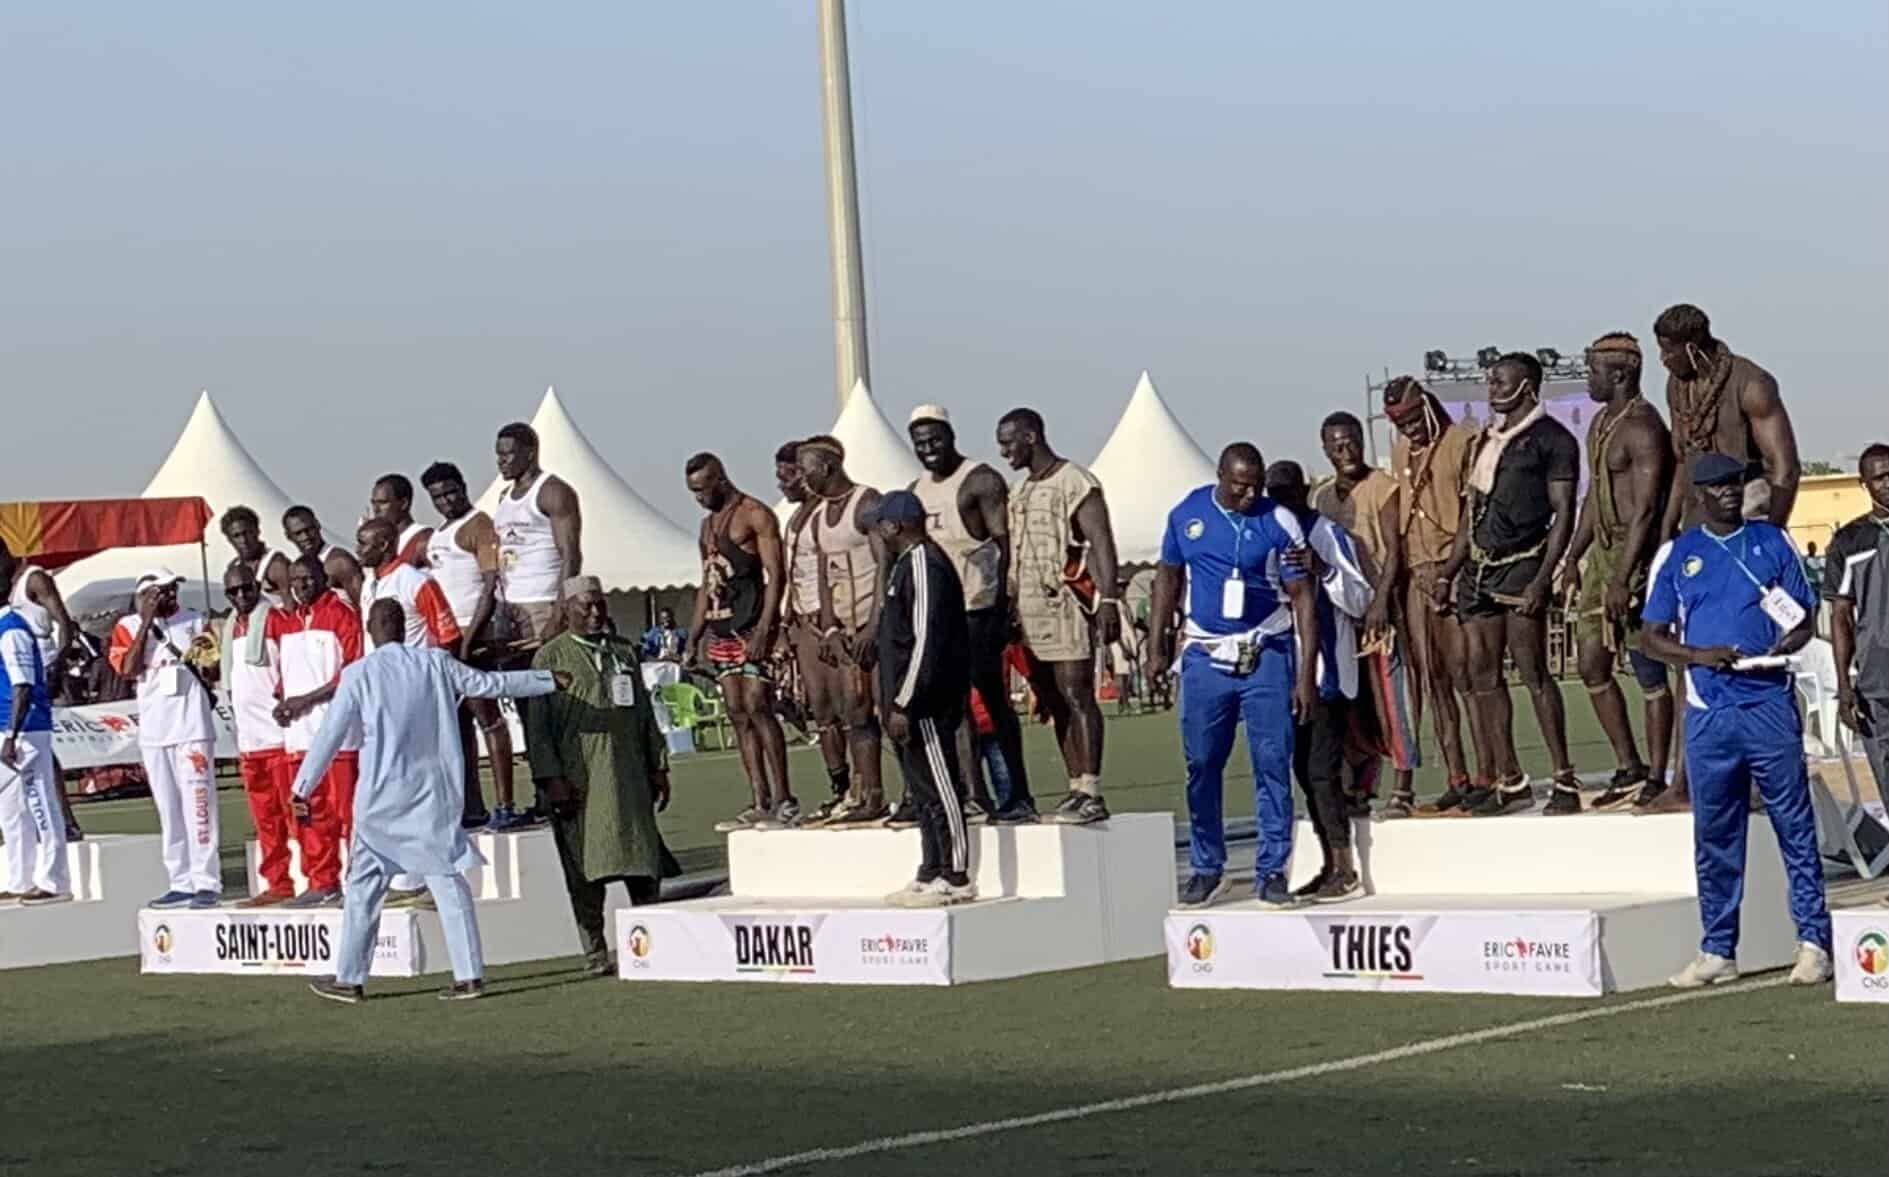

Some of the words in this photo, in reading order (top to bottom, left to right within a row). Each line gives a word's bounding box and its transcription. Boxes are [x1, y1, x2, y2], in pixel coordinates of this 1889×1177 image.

[194, 787, 208, 825] LOUIS
[215, 923, 331, 961] SAINT-LOUIS
[735, 924, 815, 966] DAKAR
[861, 937, 886, 952] ERIC
[895, 937, 928, 952] FAVRE
[1328, 924, 1412, 972] THIES
[1484, 941, 1515, 958] ERIC
[1529, 941, 1570, 959] FAVRE
[1485, 961, 1527, 972] SPORT
[1862, 976, 1889, 989] CNG
